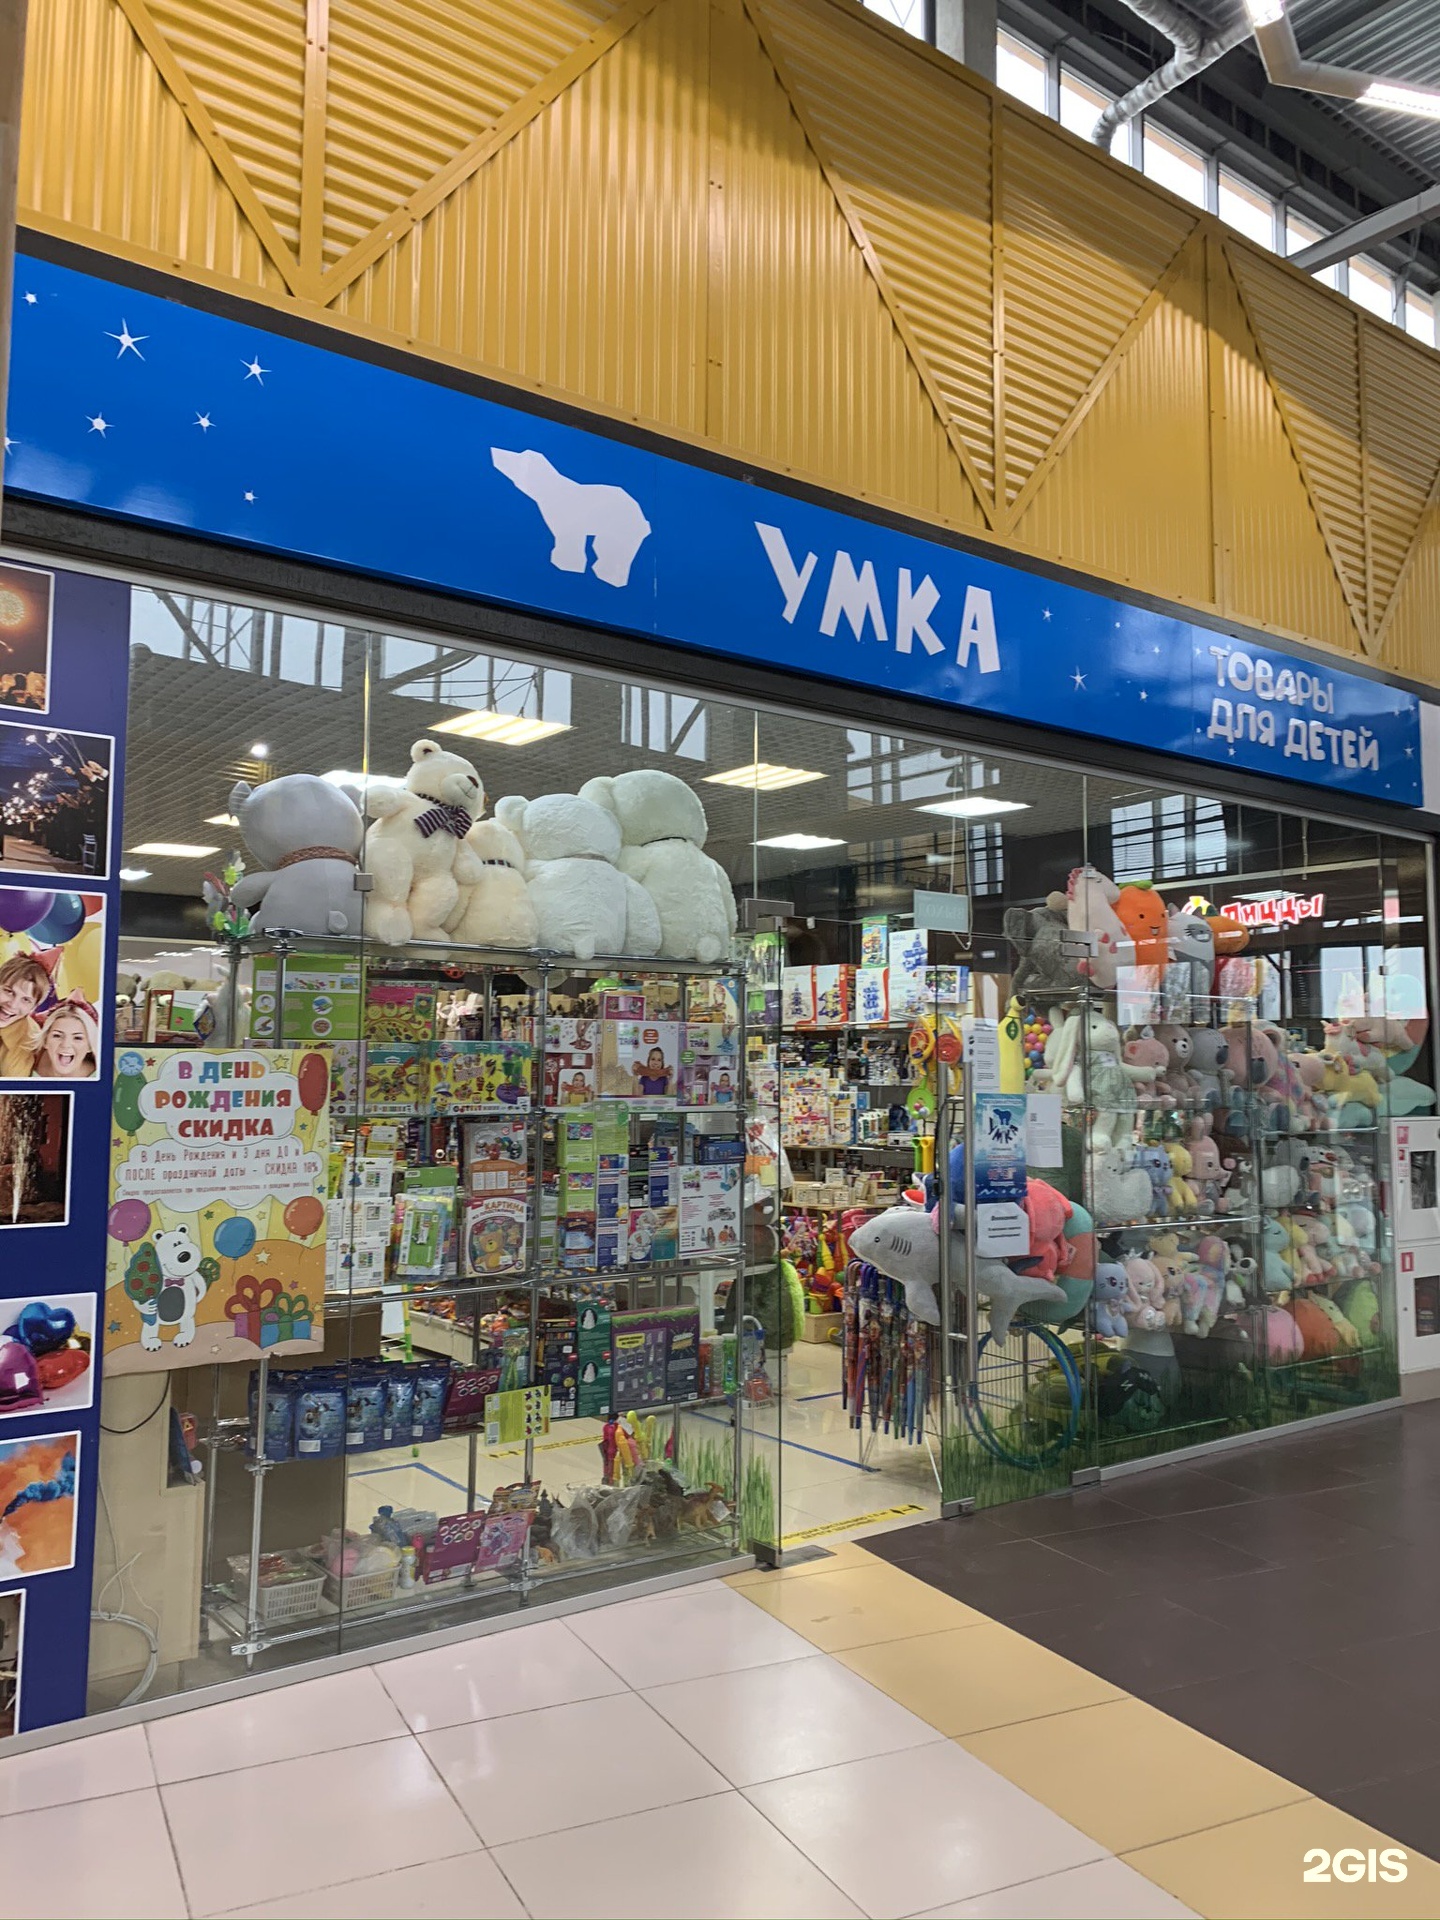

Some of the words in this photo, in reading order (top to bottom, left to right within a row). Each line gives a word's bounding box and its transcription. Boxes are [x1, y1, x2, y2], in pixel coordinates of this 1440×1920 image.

[754, 521, 1001, 674] УМКА
[1209, 645, 1334, 714] ТОВАРЫ
[1207, 698, 1275, 747] ДЛЯ
[1284, 717, 1379, 771] ДЕТЕЙ
[178, 1061, 193, 1079] В
[199, 1061, 266, 1084] ДЕНЬ
[155, 1089, 292, 1112] РОЖДЕНИЯ
[178, 1118, 274, 1141] СКИДКА
[141, 1150, 148, 1162] В
[155, 1150, 176, 1163] День
[183, 1149, 225, 1161] Рождения
[243, 1147, 248, 1158] 3
[255, 1149, 270, 1159] дня
[126, 1168, 155, 1181] ПОСЛЕ
[265, 1162, 297, 1176] СКИДКА
